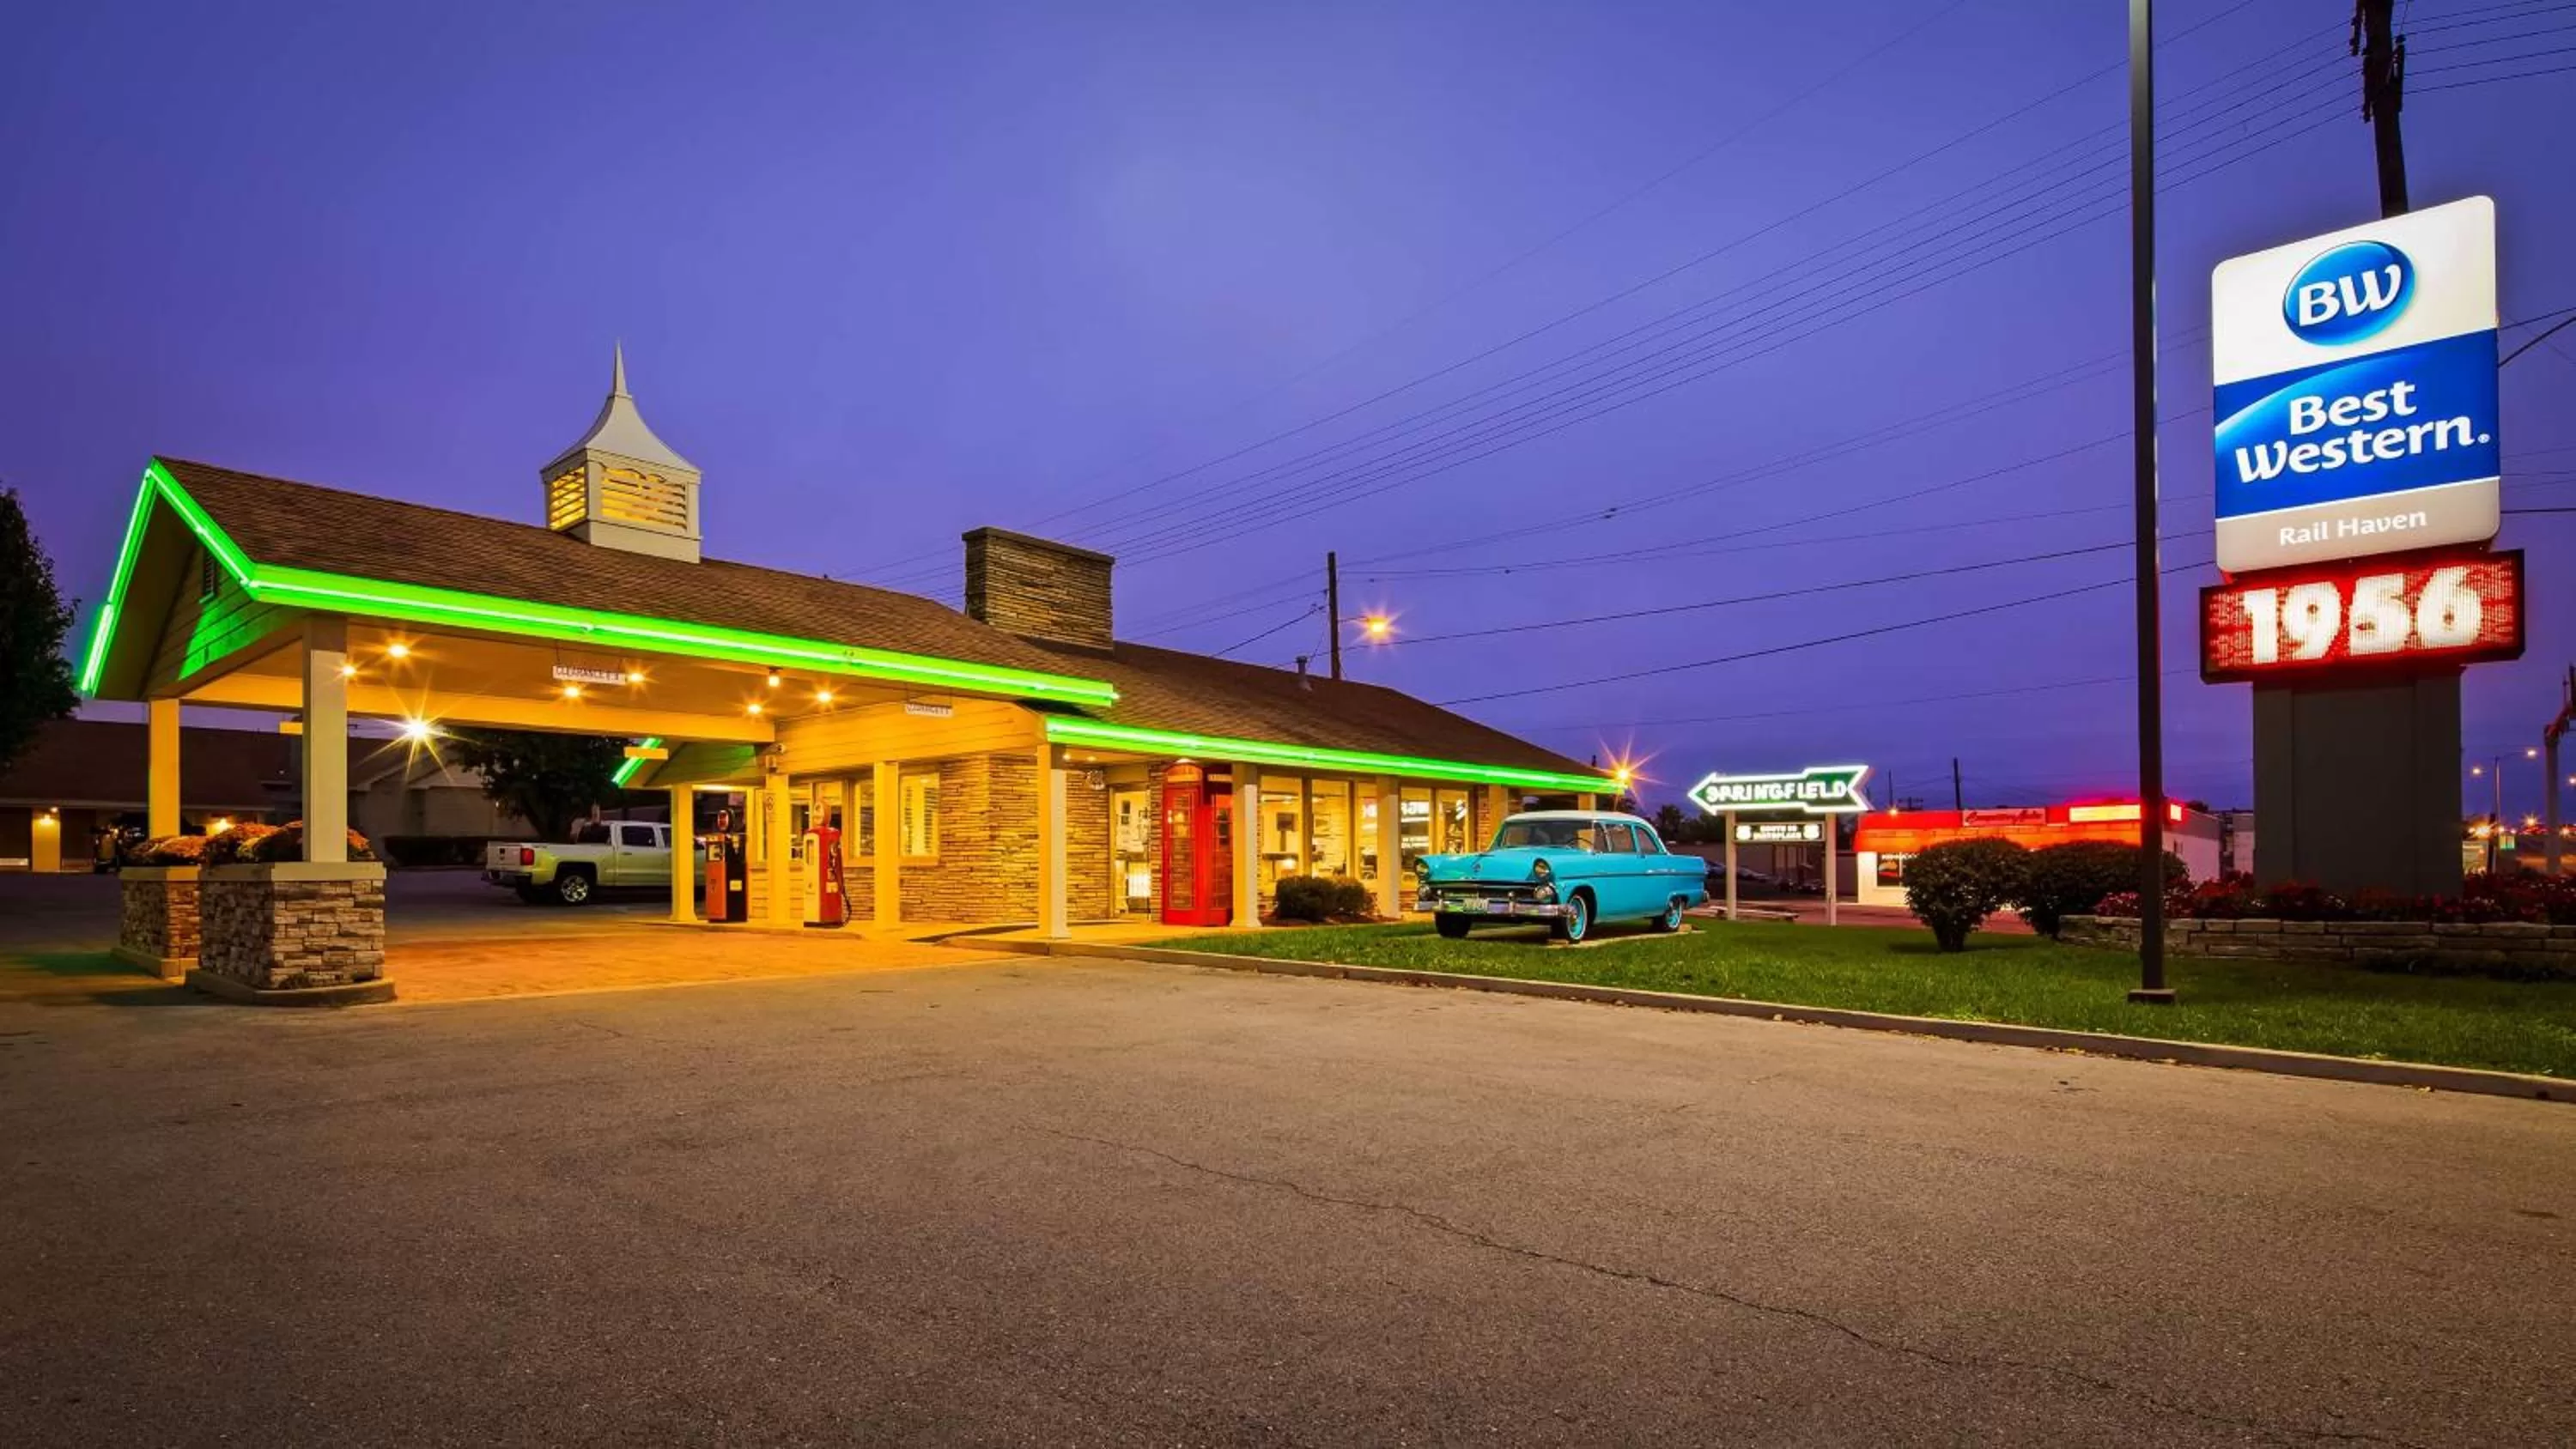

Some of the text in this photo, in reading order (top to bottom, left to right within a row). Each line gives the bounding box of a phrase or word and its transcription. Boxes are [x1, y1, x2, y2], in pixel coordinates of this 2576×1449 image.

[2299, 264, 2402, 326] BW
[2289, 380, 2418, 435] Best
[2235, 415, 2476, 483] Western
[2280, 511, 2428, 546] Rail Haven
[2243, 566, 2483, 664] 1956
[1705, 780, 1847, 803] SPRINGFIELD
